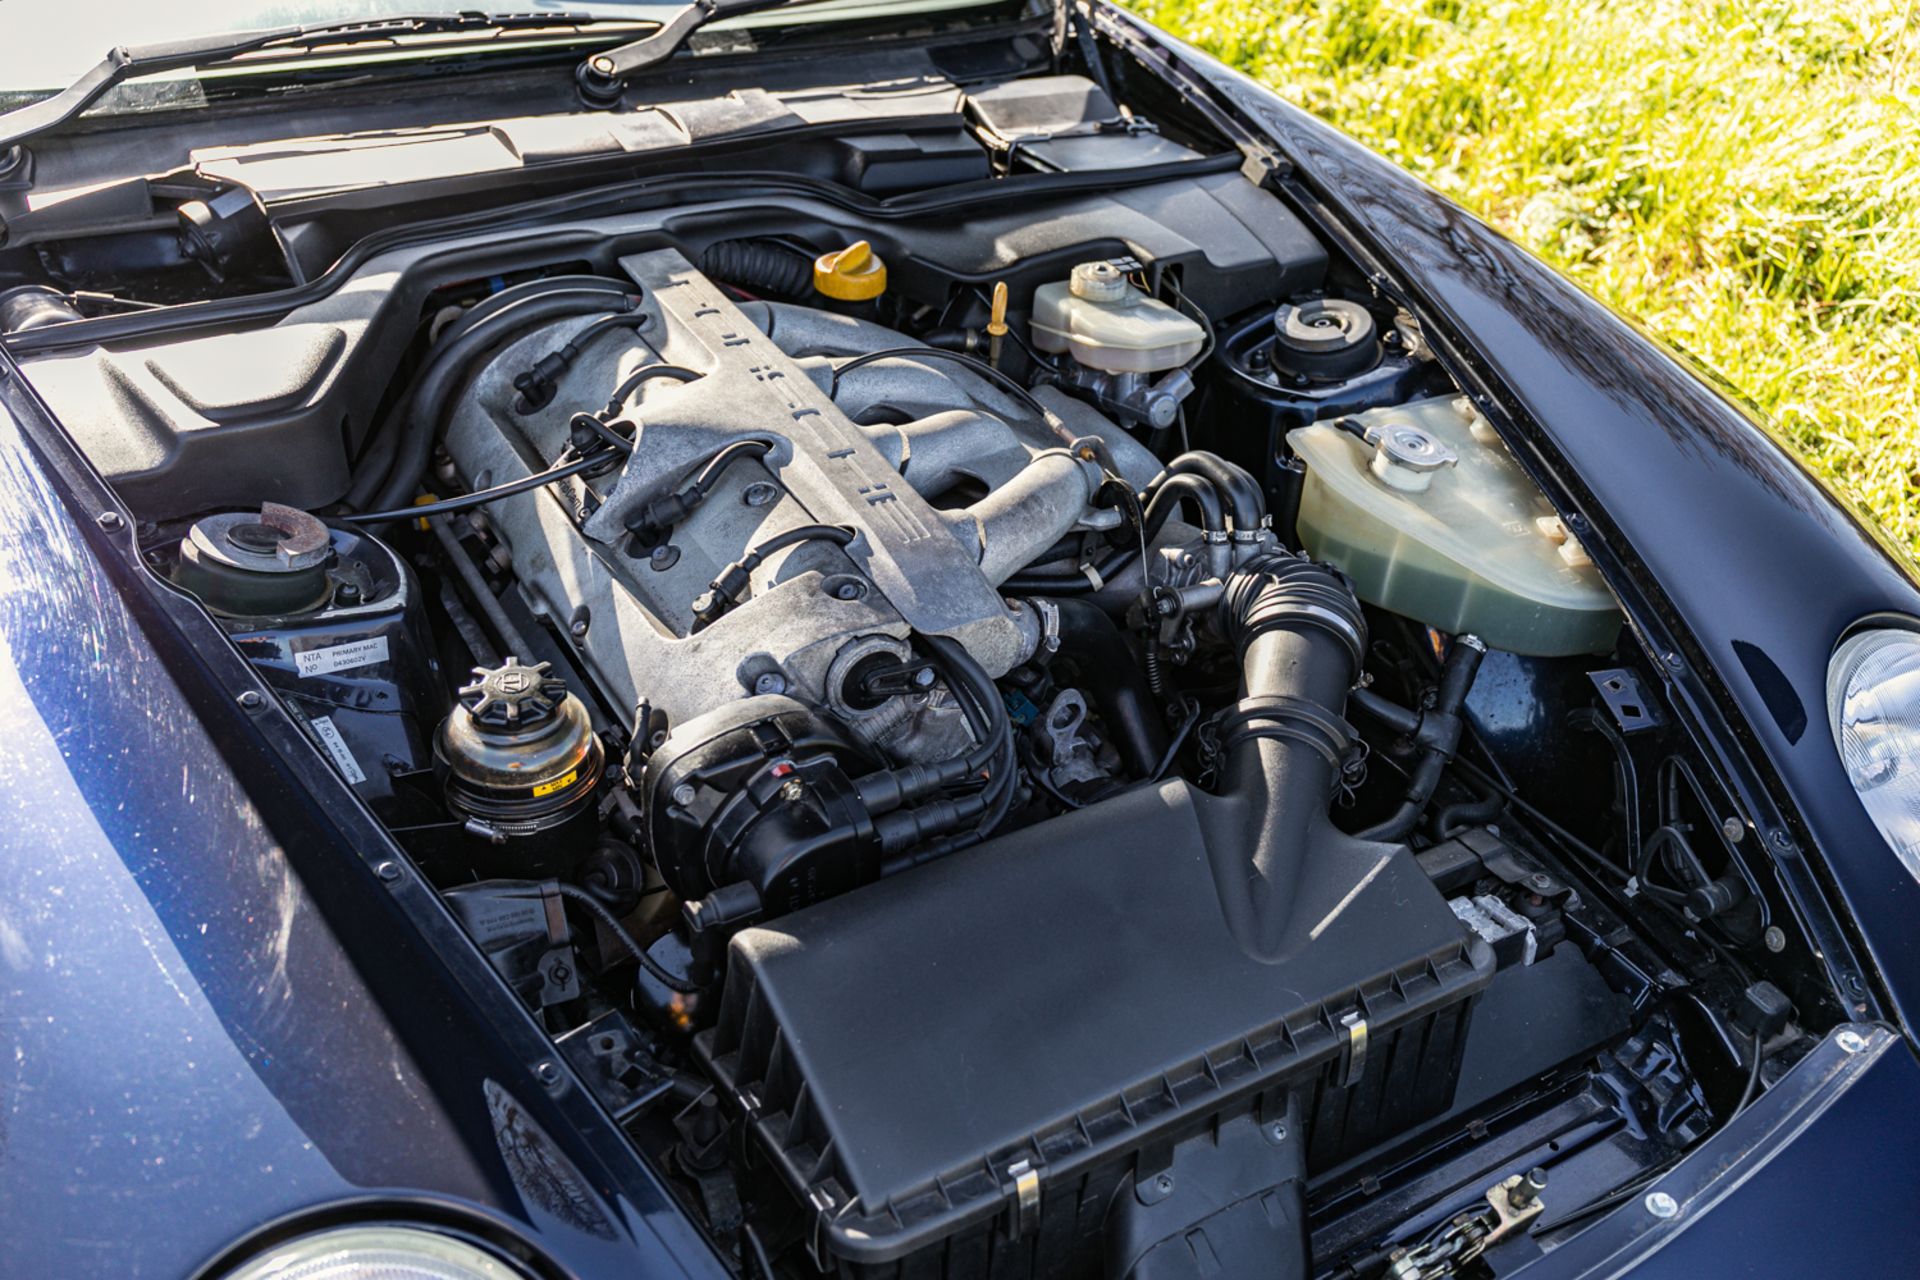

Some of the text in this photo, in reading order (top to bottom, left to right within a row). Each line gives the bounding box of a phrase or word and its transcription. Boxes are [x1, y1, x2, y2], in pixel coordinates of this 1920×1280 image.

[667, 279, 932, 545] PORSCHE
[303, 643, 378, 663] NTA PRIMARY MAC
